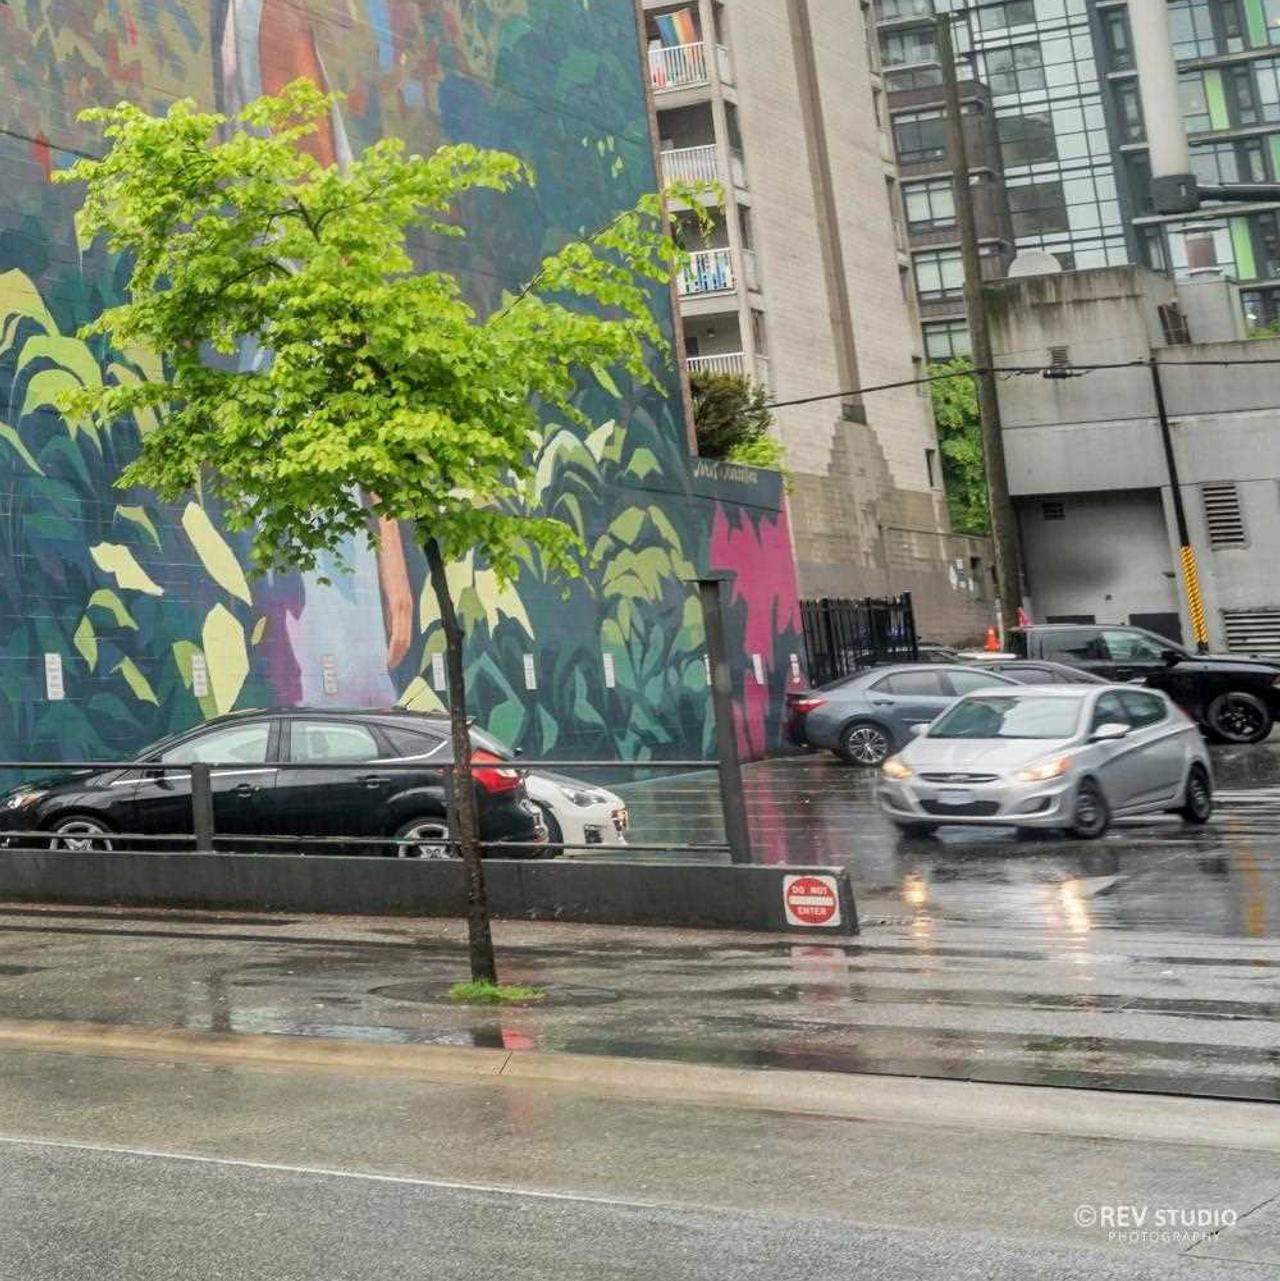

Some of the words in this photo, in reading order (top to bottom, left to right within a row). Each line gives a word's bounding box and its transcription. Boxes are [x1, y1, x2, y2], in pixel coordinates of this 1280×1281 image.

[791, 886, 806, 894] DO
[810, 886, 828, 895] NOT
[797, 906, 827, 915] ENTER
